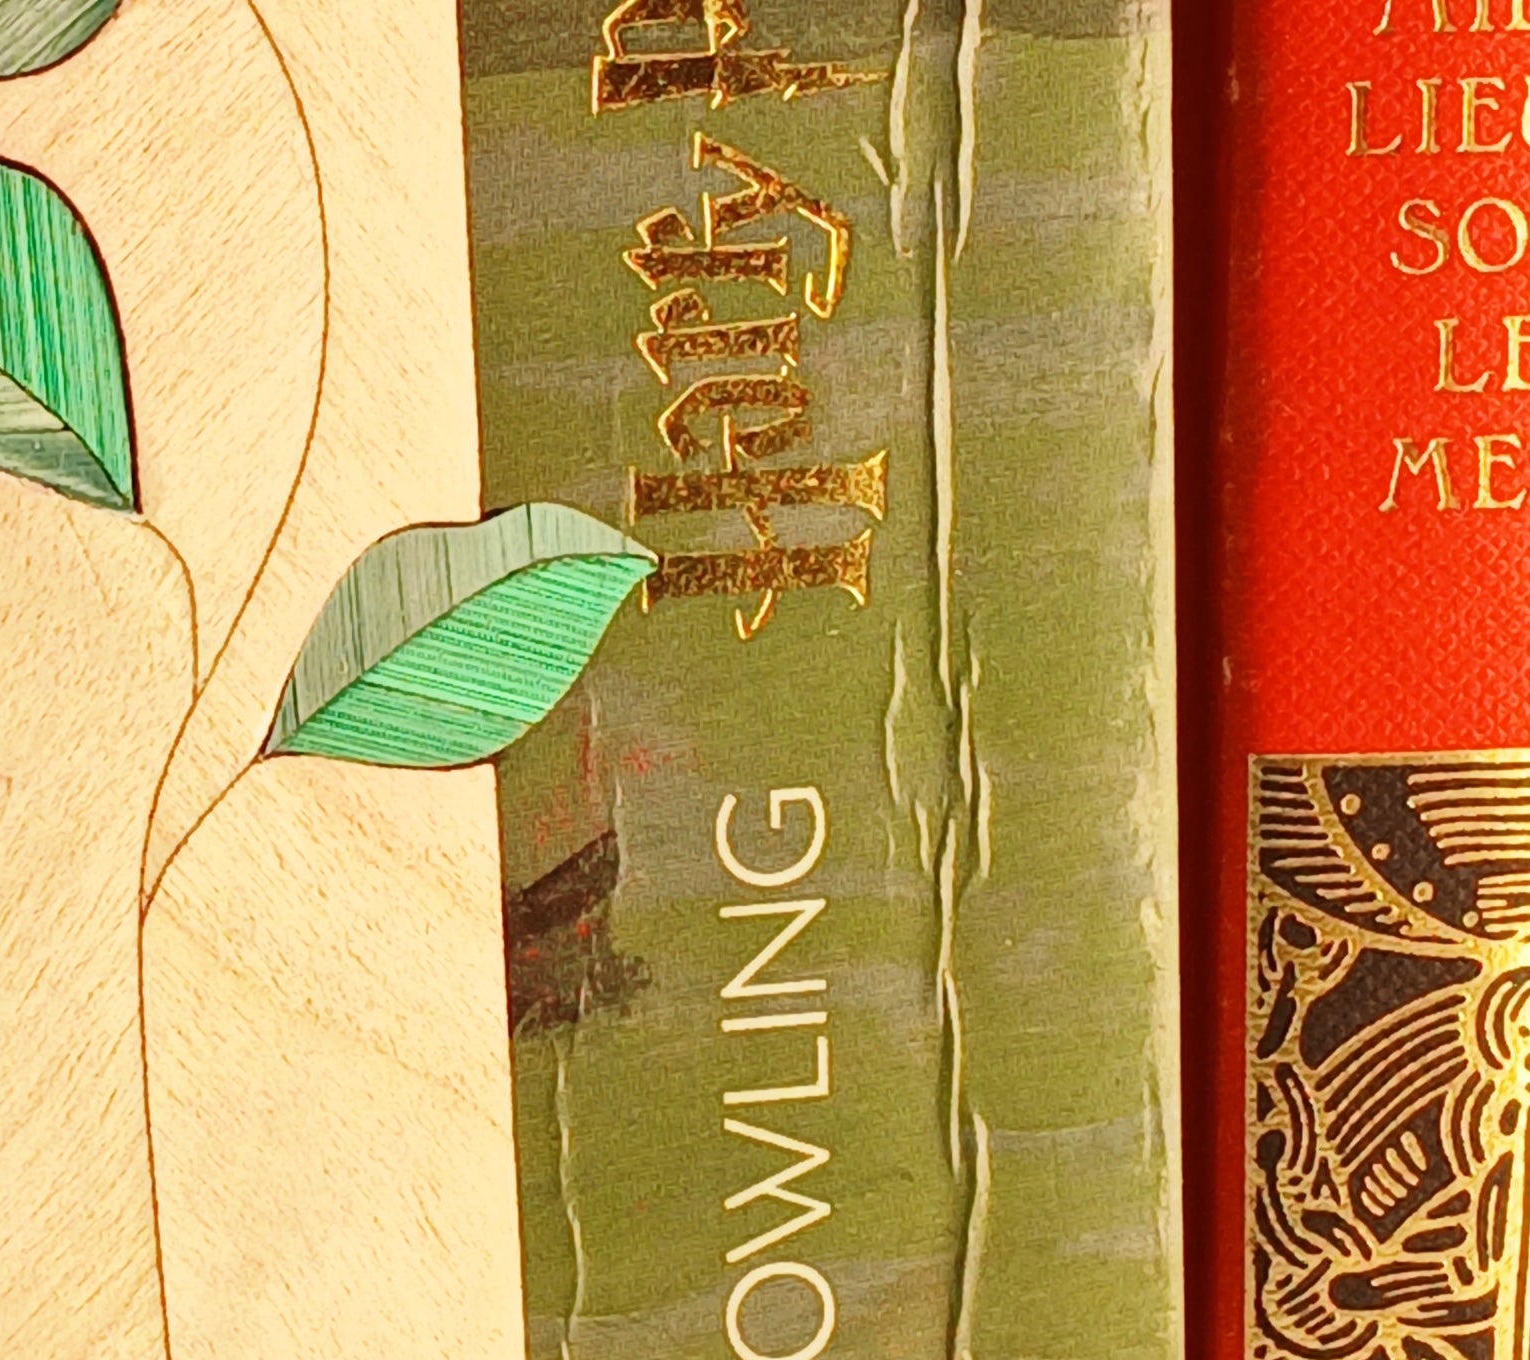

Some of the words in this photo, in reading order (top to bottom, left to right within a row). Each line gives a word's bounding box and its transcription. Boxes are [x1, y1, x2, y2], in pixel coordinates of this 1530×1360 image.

[1345, 75, 1530, 156] LIE
[1390, 197, 1528, 275] SO
[627, 130, 888, 639] Harry
[1378, 434, 1528, 511] ME
